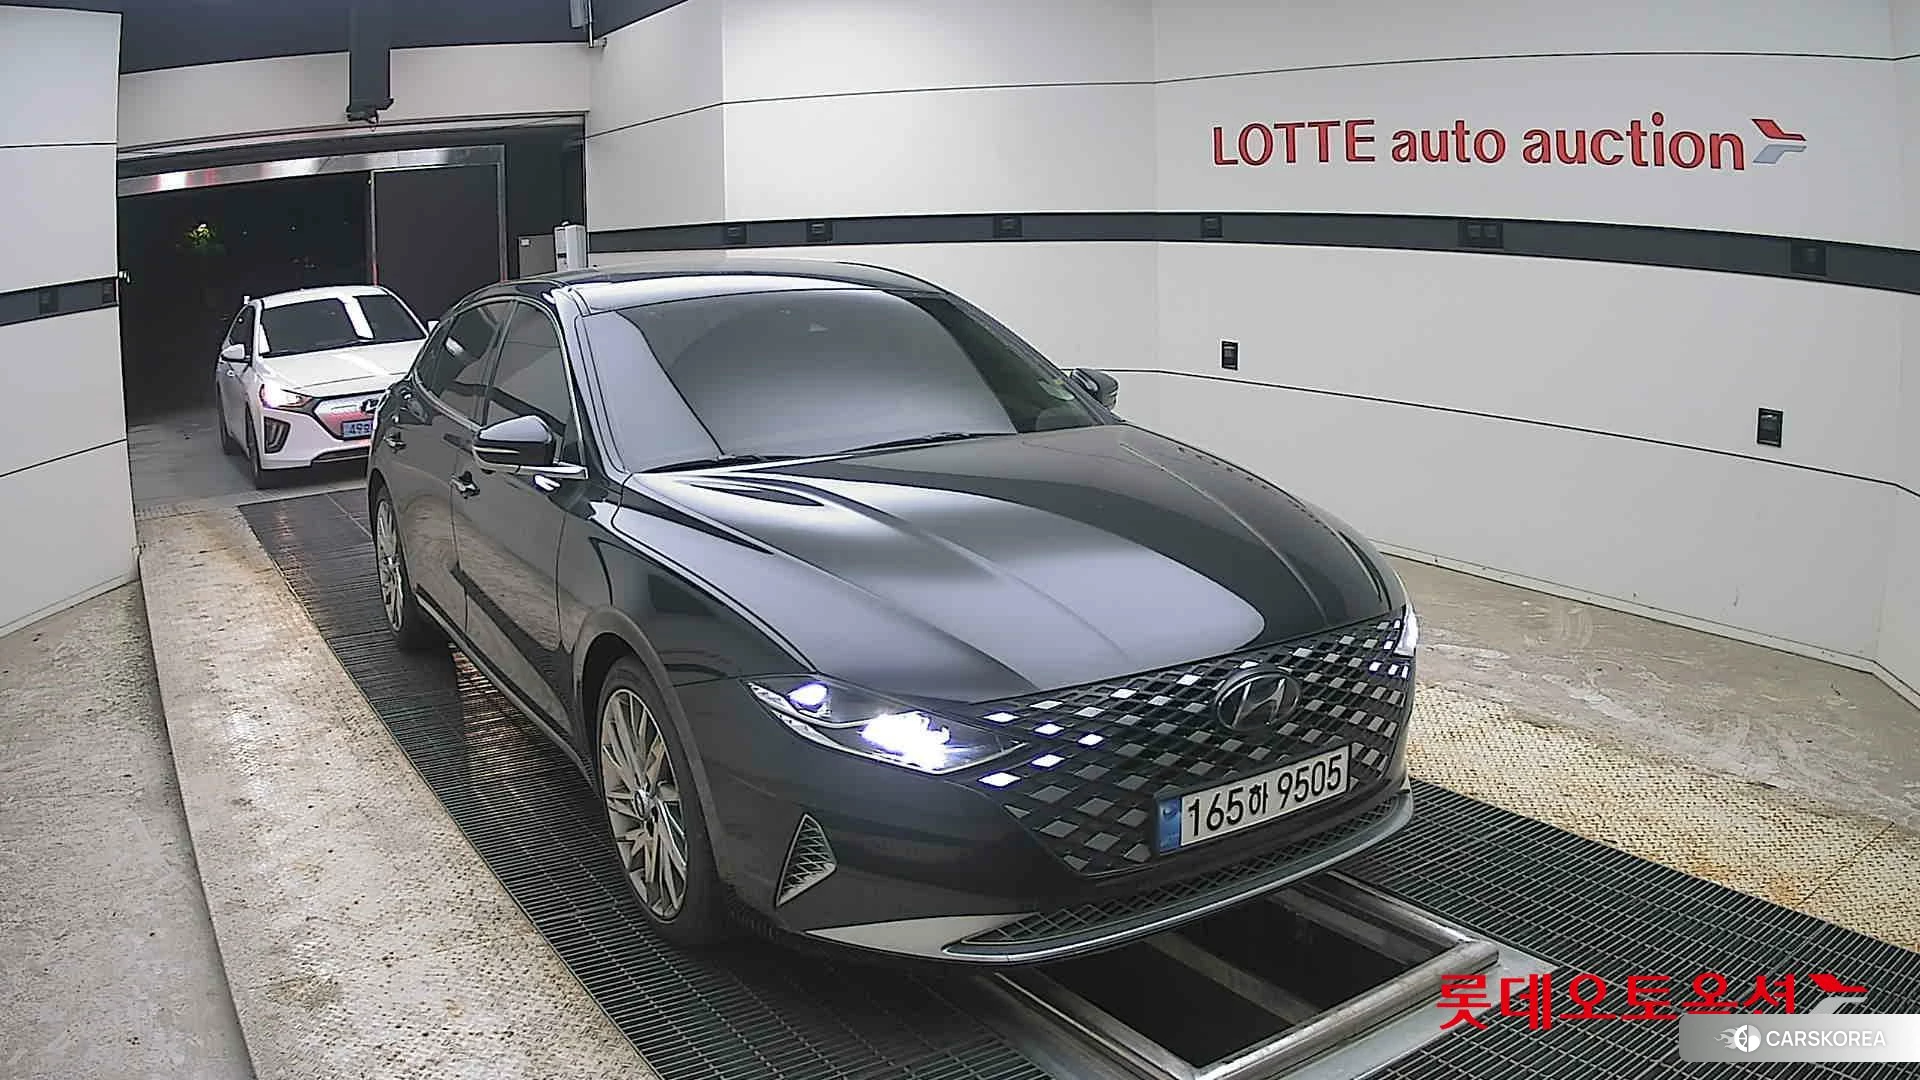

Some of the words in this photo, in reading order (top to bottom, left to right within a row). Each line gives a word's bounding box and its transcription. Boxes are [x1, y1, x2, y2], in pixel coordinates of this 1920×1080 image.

[1213, 119, 1376, 167] LOTTE
[1391, 120, 1508, 163] auto
[1522, 112, 1745, 171] auction
[1188, 781, 1268, 837] 165하
[1277, 754, 1342, 809] 9505
